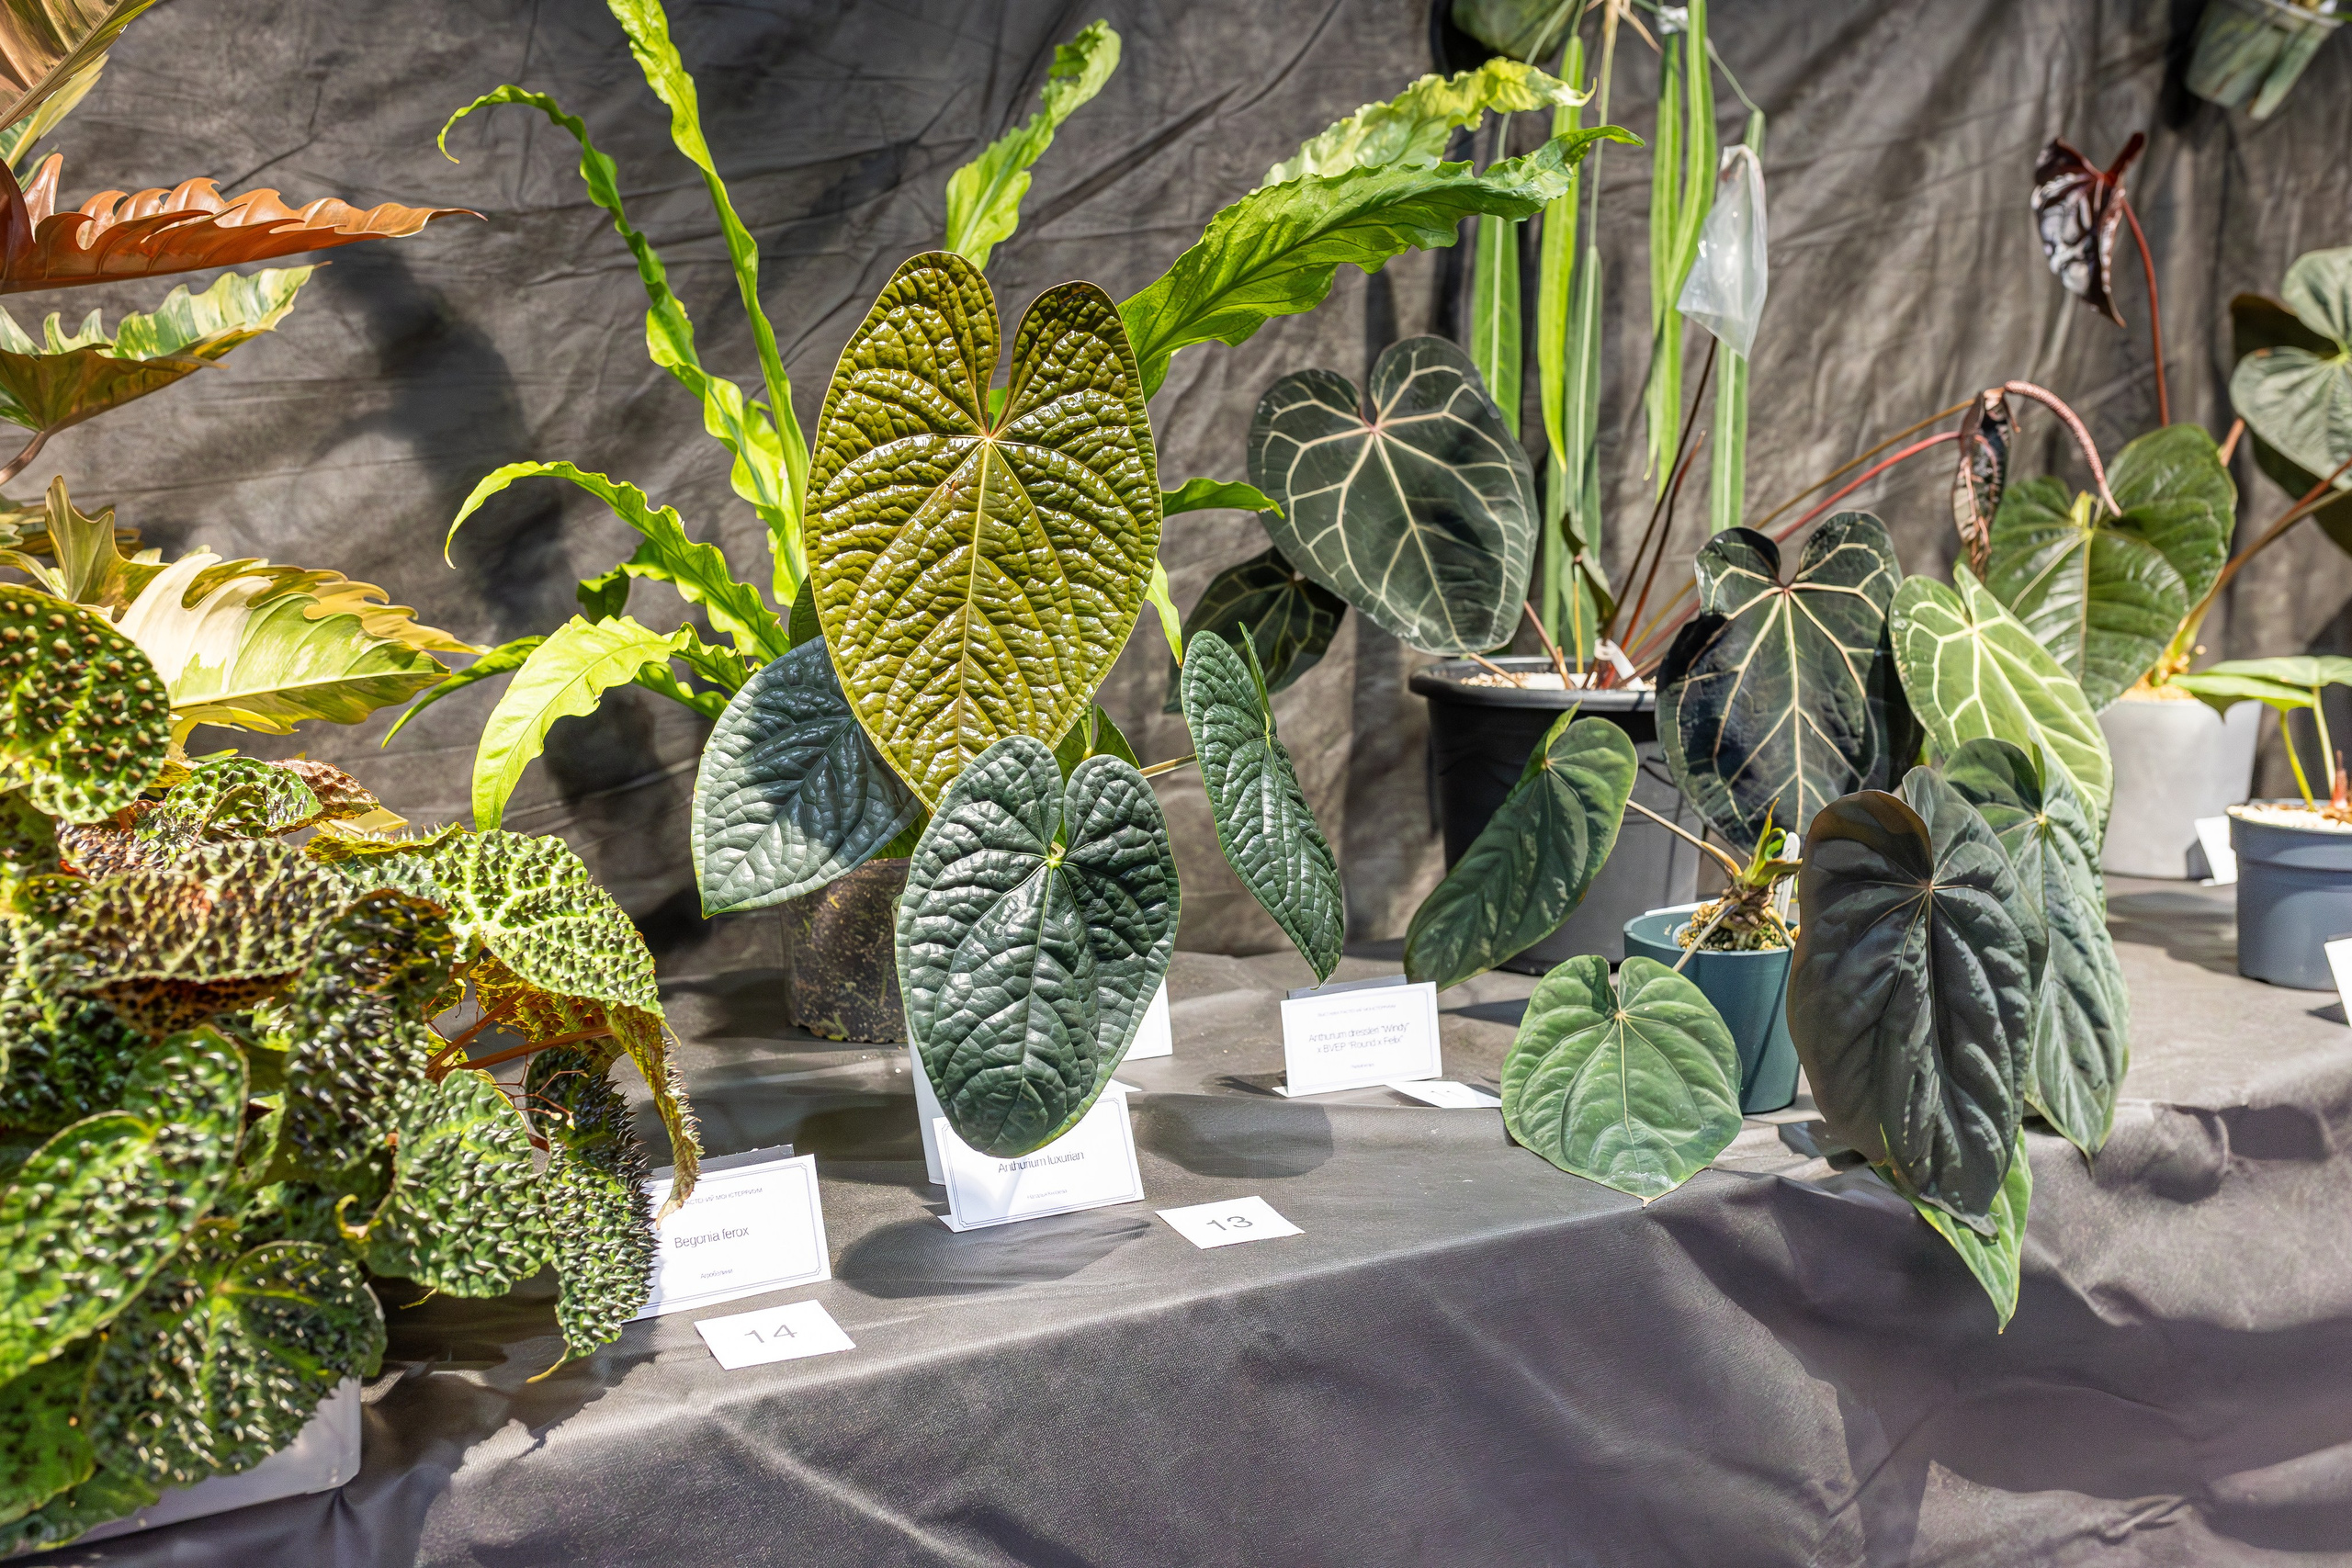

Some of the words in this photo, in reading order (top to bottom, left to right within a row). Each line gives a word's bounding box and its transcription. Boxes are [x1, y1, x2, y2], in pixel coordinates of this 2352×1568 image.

[1308, 1031, 1347, 1043] Anthurium
[1323, 1043, 1347, 1054] BVEP
[998, 1157, 1046, 1173] Anthurium
[1047, 1151, 1084, 1165] luxurian
[1206, 1215, 1253, 1231] 13
[674, 1231, 720, 1248] Begonia
[722, 1227, 750, 1240] ferox
[744, 1324, 797, 1343] 14
